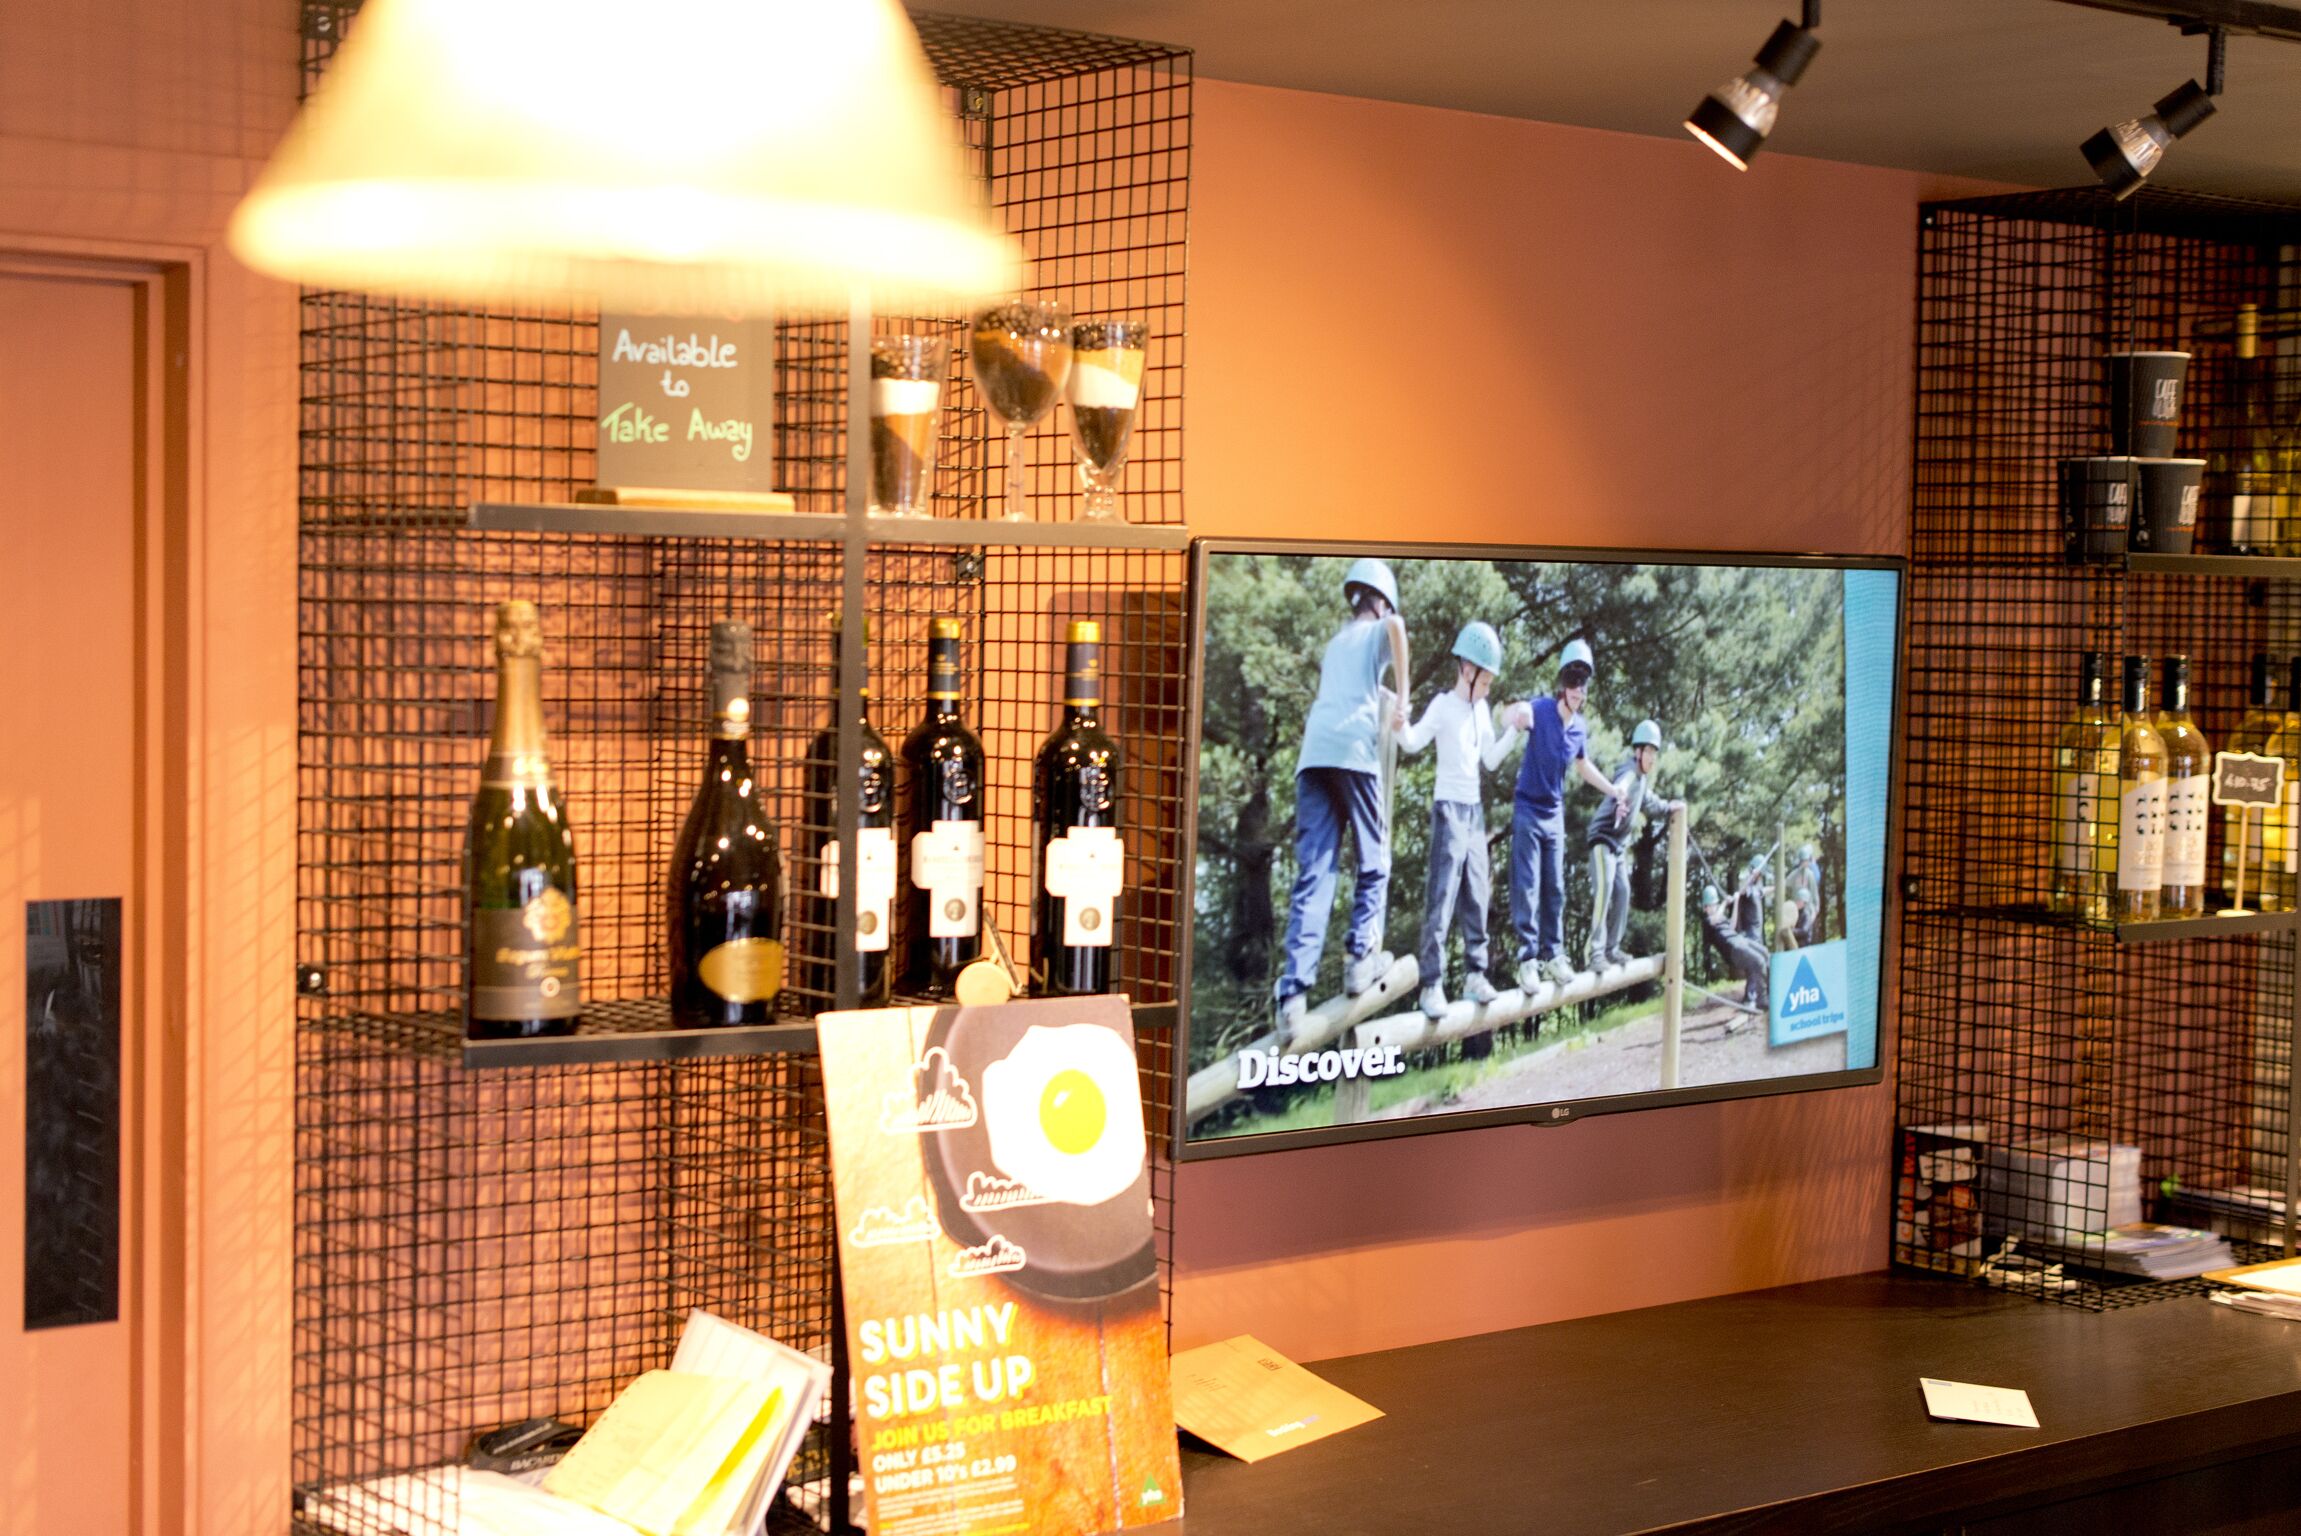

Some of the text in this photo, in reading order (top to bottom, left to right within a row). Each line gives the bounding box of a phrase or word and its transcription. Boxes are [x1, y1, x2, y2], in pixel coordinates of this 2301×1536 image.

[611, 328, 738, 368] Available
[660, 370, 690, 397] to
[600, 402, 753, 462] Take Away
[1789, 985, 1820, 1012] yha
[1790, 1012, 1844, 1031] school trips
[1237, 1045, 1406, 1089] Discover.
[859, 1302, 1018, 1365] SUNNY
[864, 1355, 1036, 1420] SIDE UP
[872, 1394, 1114, 1451] JOIN US FOR BREAKFAST
[872, 1449, 918, 1473] ONLY
[874, 1469, 935, 1494] UNDER
[970, 1454, 1018, 1478] £2.99
